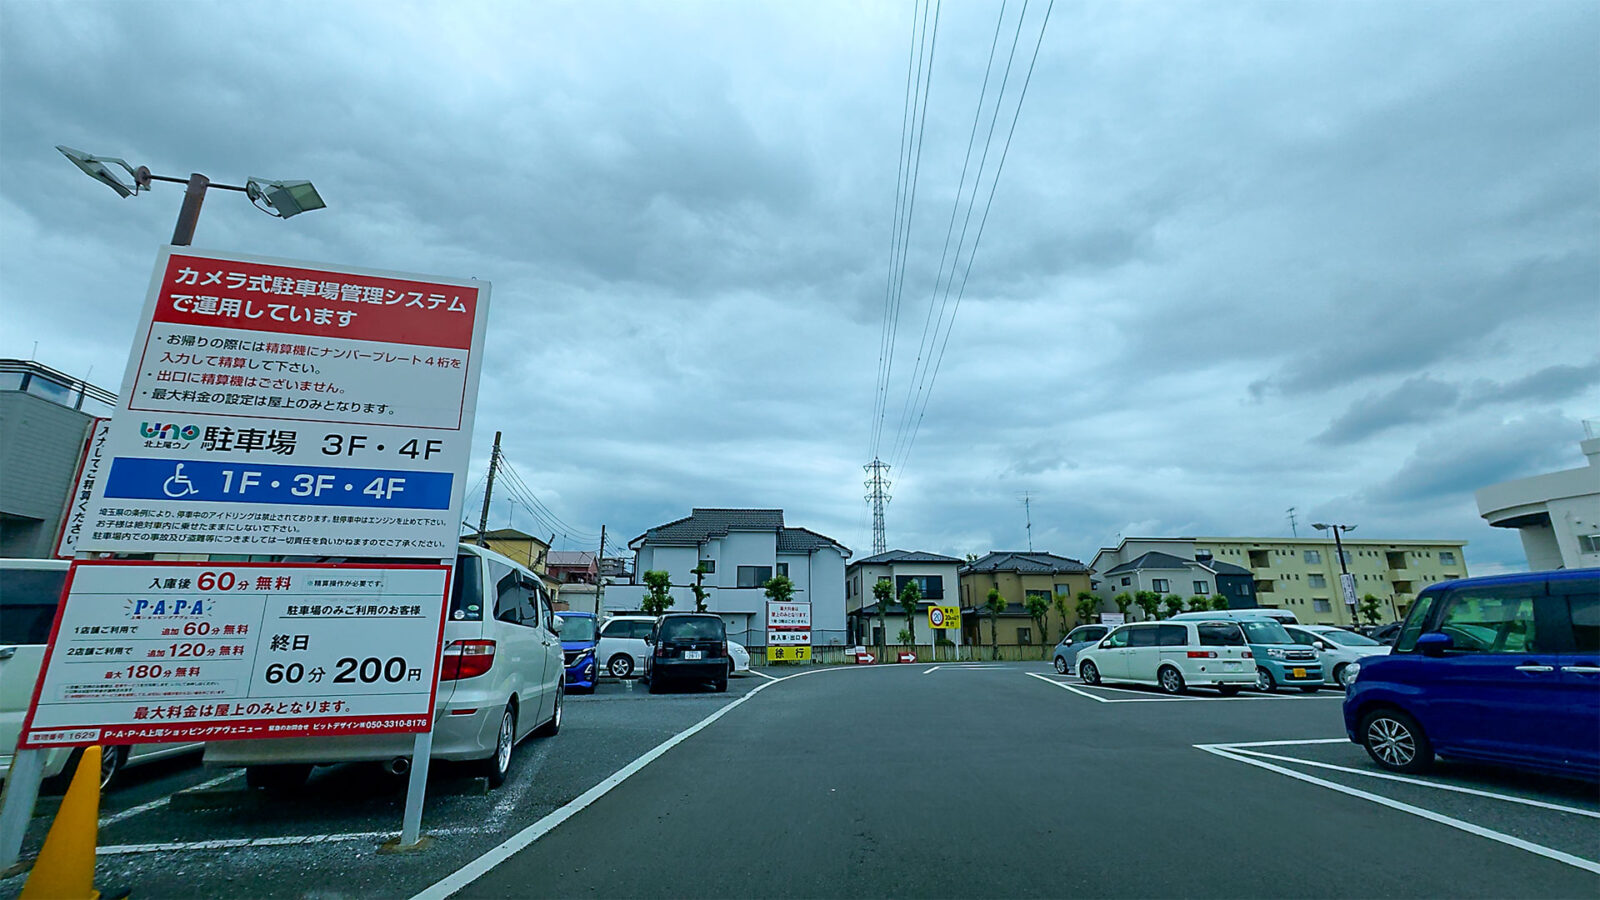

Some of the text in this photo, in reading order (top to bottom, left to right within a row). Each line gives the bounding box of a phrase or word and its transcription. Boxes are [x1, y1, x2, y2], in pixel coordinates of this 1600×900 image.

[175, 266, 468, 315] カメラ式駐車場管理システム
[169, 293, 359, 328] で運用しています
[159, 350, 322, 375] 入力して精算して下さい。
[200, 426, 297, 456] 駐車場
[149, 577, 191, 591] 入庫後
[255, 575, 292, 591] 無料
[286, 604, 421, 617] 駐車場のみご利用のお客様
[74, 625, 139, 636] 1店舗ご利用で
[160, 627, 179, 637] 追加
[223, 624, 249, 635] 無料
[66, 646, 134, 657] 2店舗ご利用で
[146, 649, 166, 658] 追加
[218, 644, 245, 657] 無料
[270, 634, 310, 652] 終日
[103, 671, 122, 680] 最大
[174, 666, 201, 678] 無料
[68, 731, 96, 740] 1629
